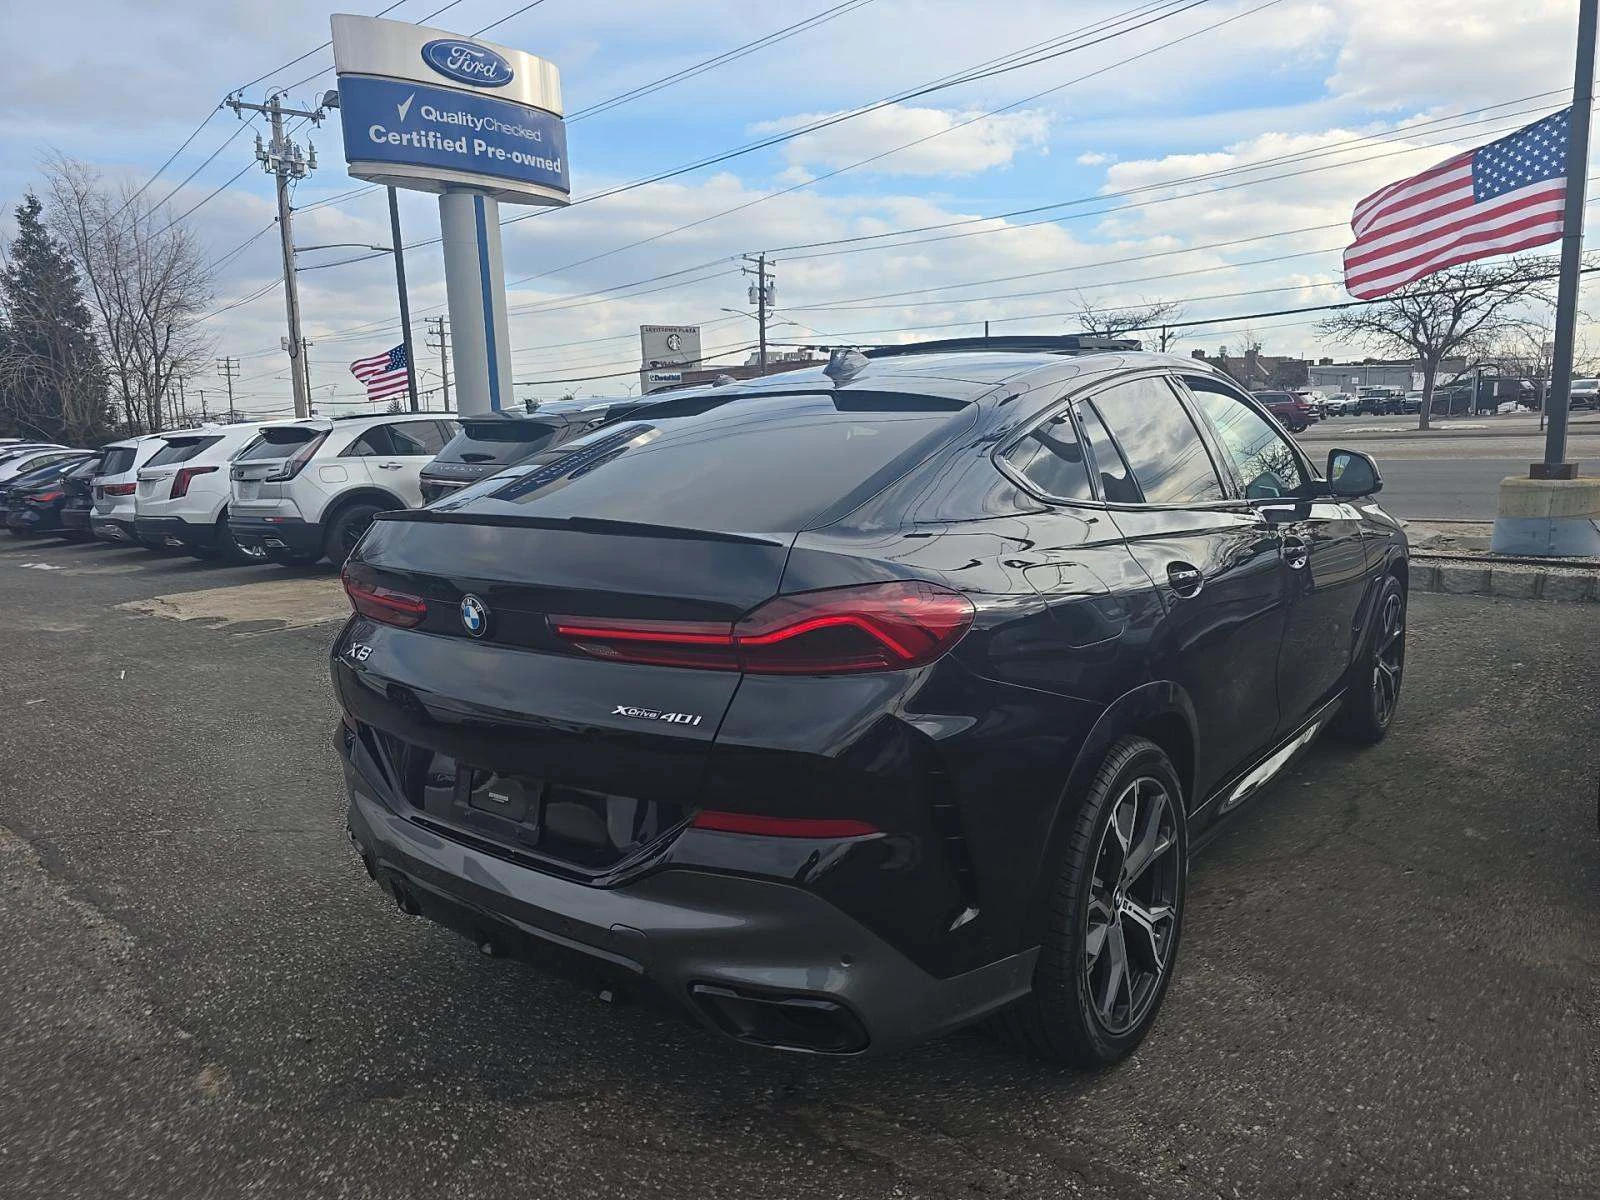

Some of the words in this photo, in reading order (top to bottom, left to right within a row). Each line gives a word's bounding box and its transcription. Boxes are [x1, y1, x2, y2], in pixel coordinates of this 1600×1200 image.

[447, 46, 497, 78] Ford
[421, 105, 542, 142] QualityChecked
[368, 124, 467, 154] Certified
[473, 139, 562, 174] Pre-owned
